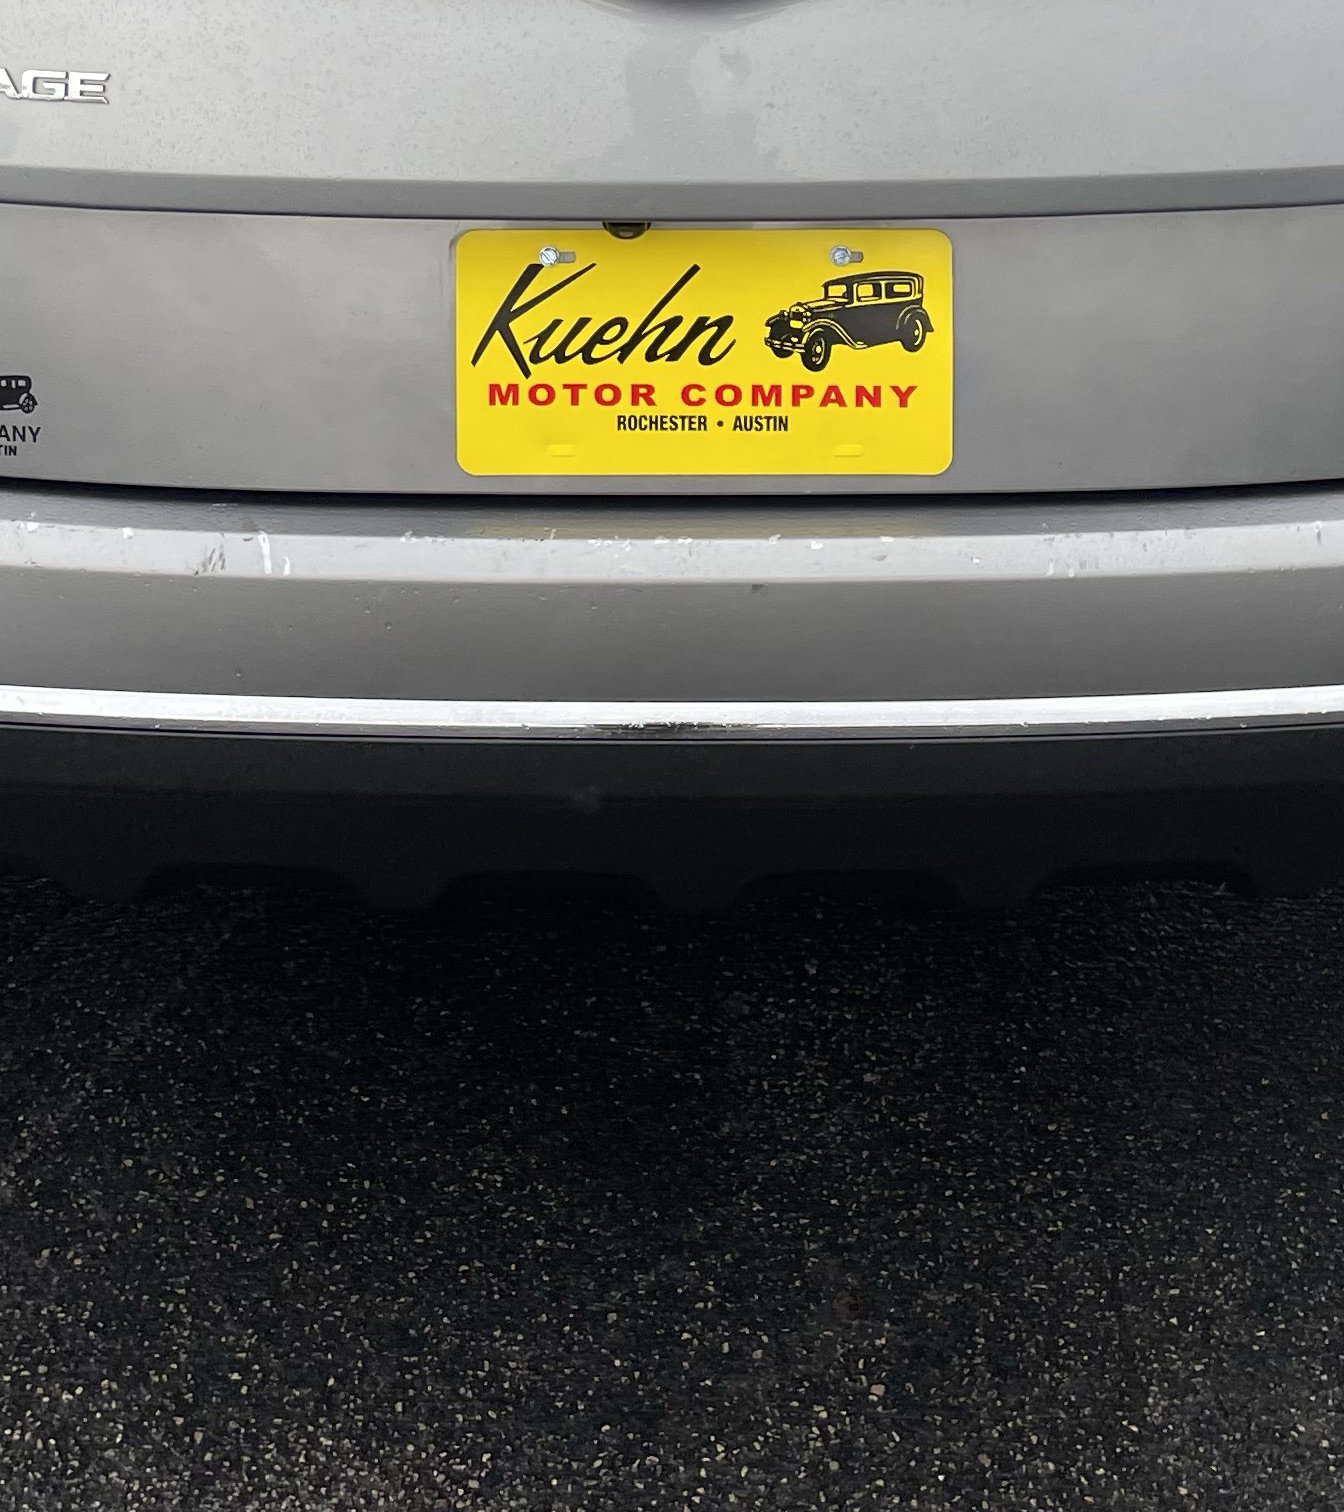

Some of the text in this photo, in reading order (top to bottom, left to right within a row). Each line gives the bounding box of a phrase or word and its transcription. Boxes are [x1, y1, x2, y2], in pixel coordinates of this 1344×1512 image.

[471, 262, 737, 380] Kuehn
[488, 383, 918, 409] MOTOR COMPANY
[616, 414, 789, 432] ROCHESTER AUSTIN
